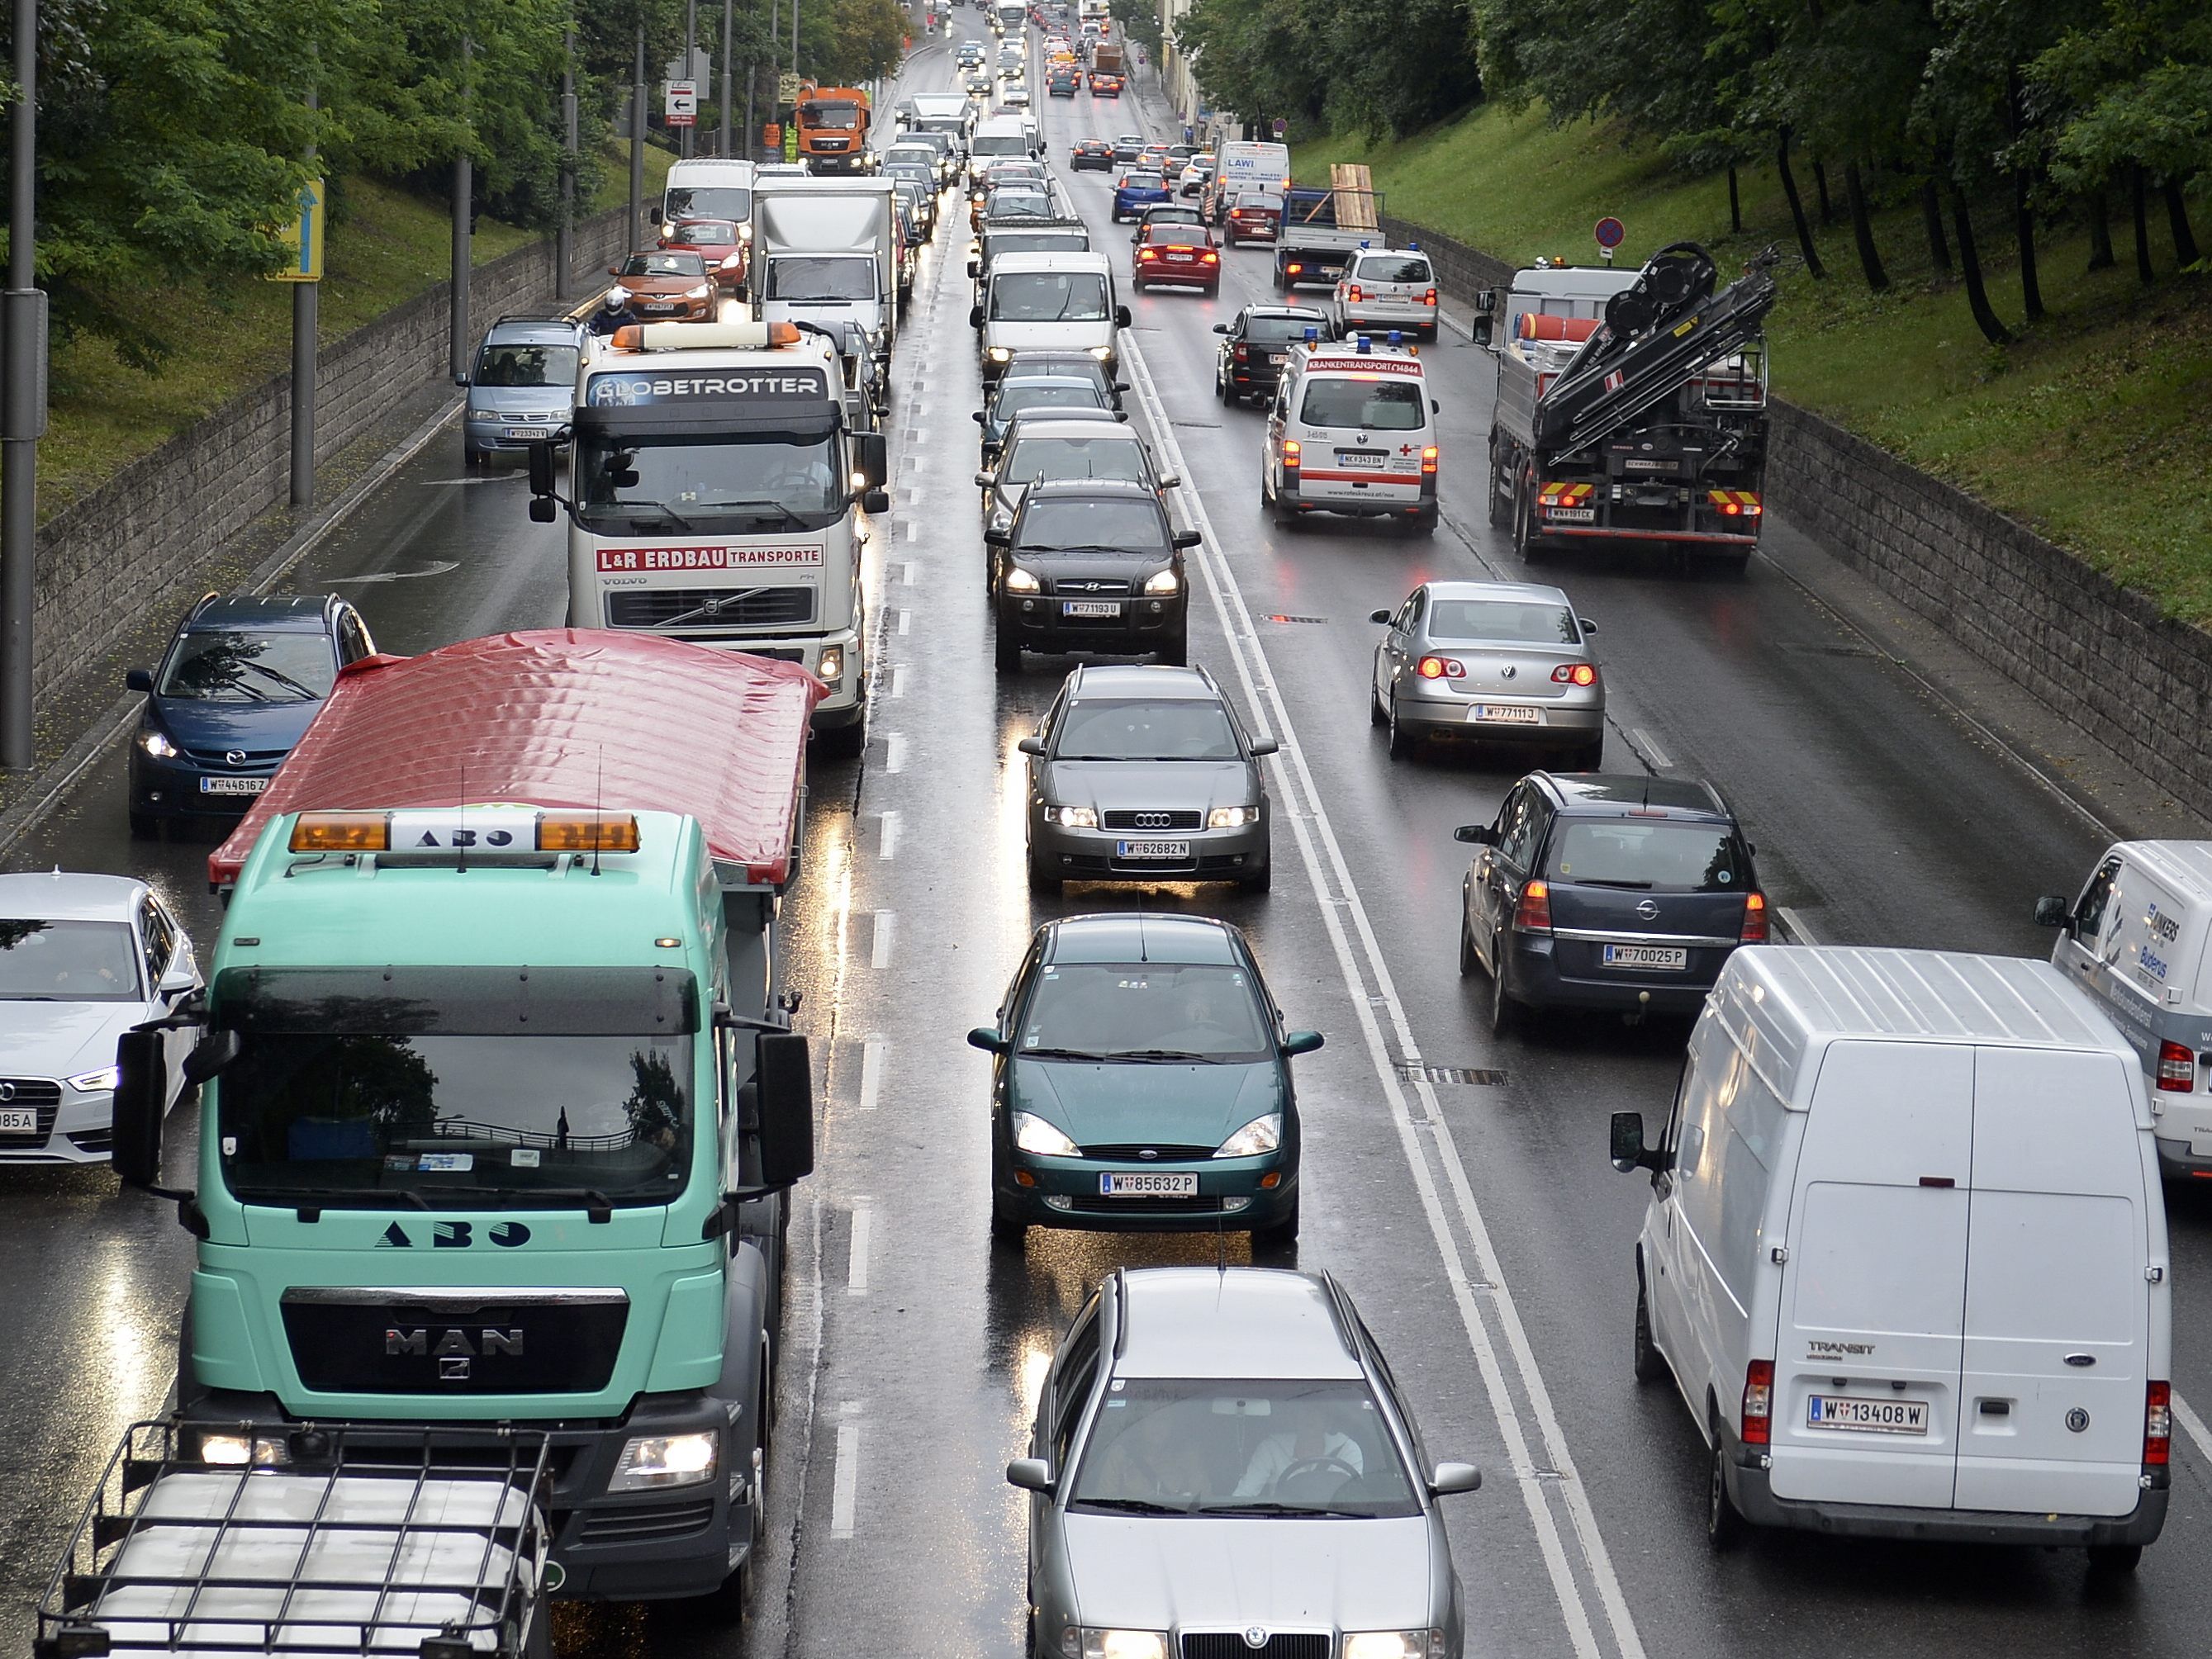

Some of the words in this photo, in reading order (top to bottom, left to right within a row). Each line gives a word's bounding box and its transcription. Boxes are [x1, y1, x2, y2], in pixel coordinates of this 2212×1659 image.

[1228, 159, 1254, 168] LAWI
[1309, 361, 1392, 371] KRANKENTRANSPORT
[596, 377, 819, 398] GLOBETROTTER
[601, 552, 638, 569] L&R
[645, 550, 724, 568] ERDBAU
[730, 550, 819, 563] TRANSPORTE
[1085, 604, 1109, 613] 71193
[225, 780, 256, 790] 44616
[415, 830, 513, 846] ABO
[1143, 843, 1177, 854] 62682
[1615, 948, 1623, 960] W
[1633, 949, 1672, 963] 70025
[2140, 946, 2167, 979] Buderus
[2201, 1031, 2212, 1041] W
[0, 1114, 20, 1127] 85
[22, 1114, 31, 1127] A
[1113, 1177, 1123, 1191] W
[1135, 1177, 1180, 1191] 85632
[374, 1221, 531, 1248] ABO
[386, 1330, 524, 1356] MAN
[1808, 1341, 1876, 1355] TRANSIT
[1825, 1401, 1838, 1420] W
[1852, 1403, 1905, 1424] 13408
[1908, 1406, 1921, 1425] W
